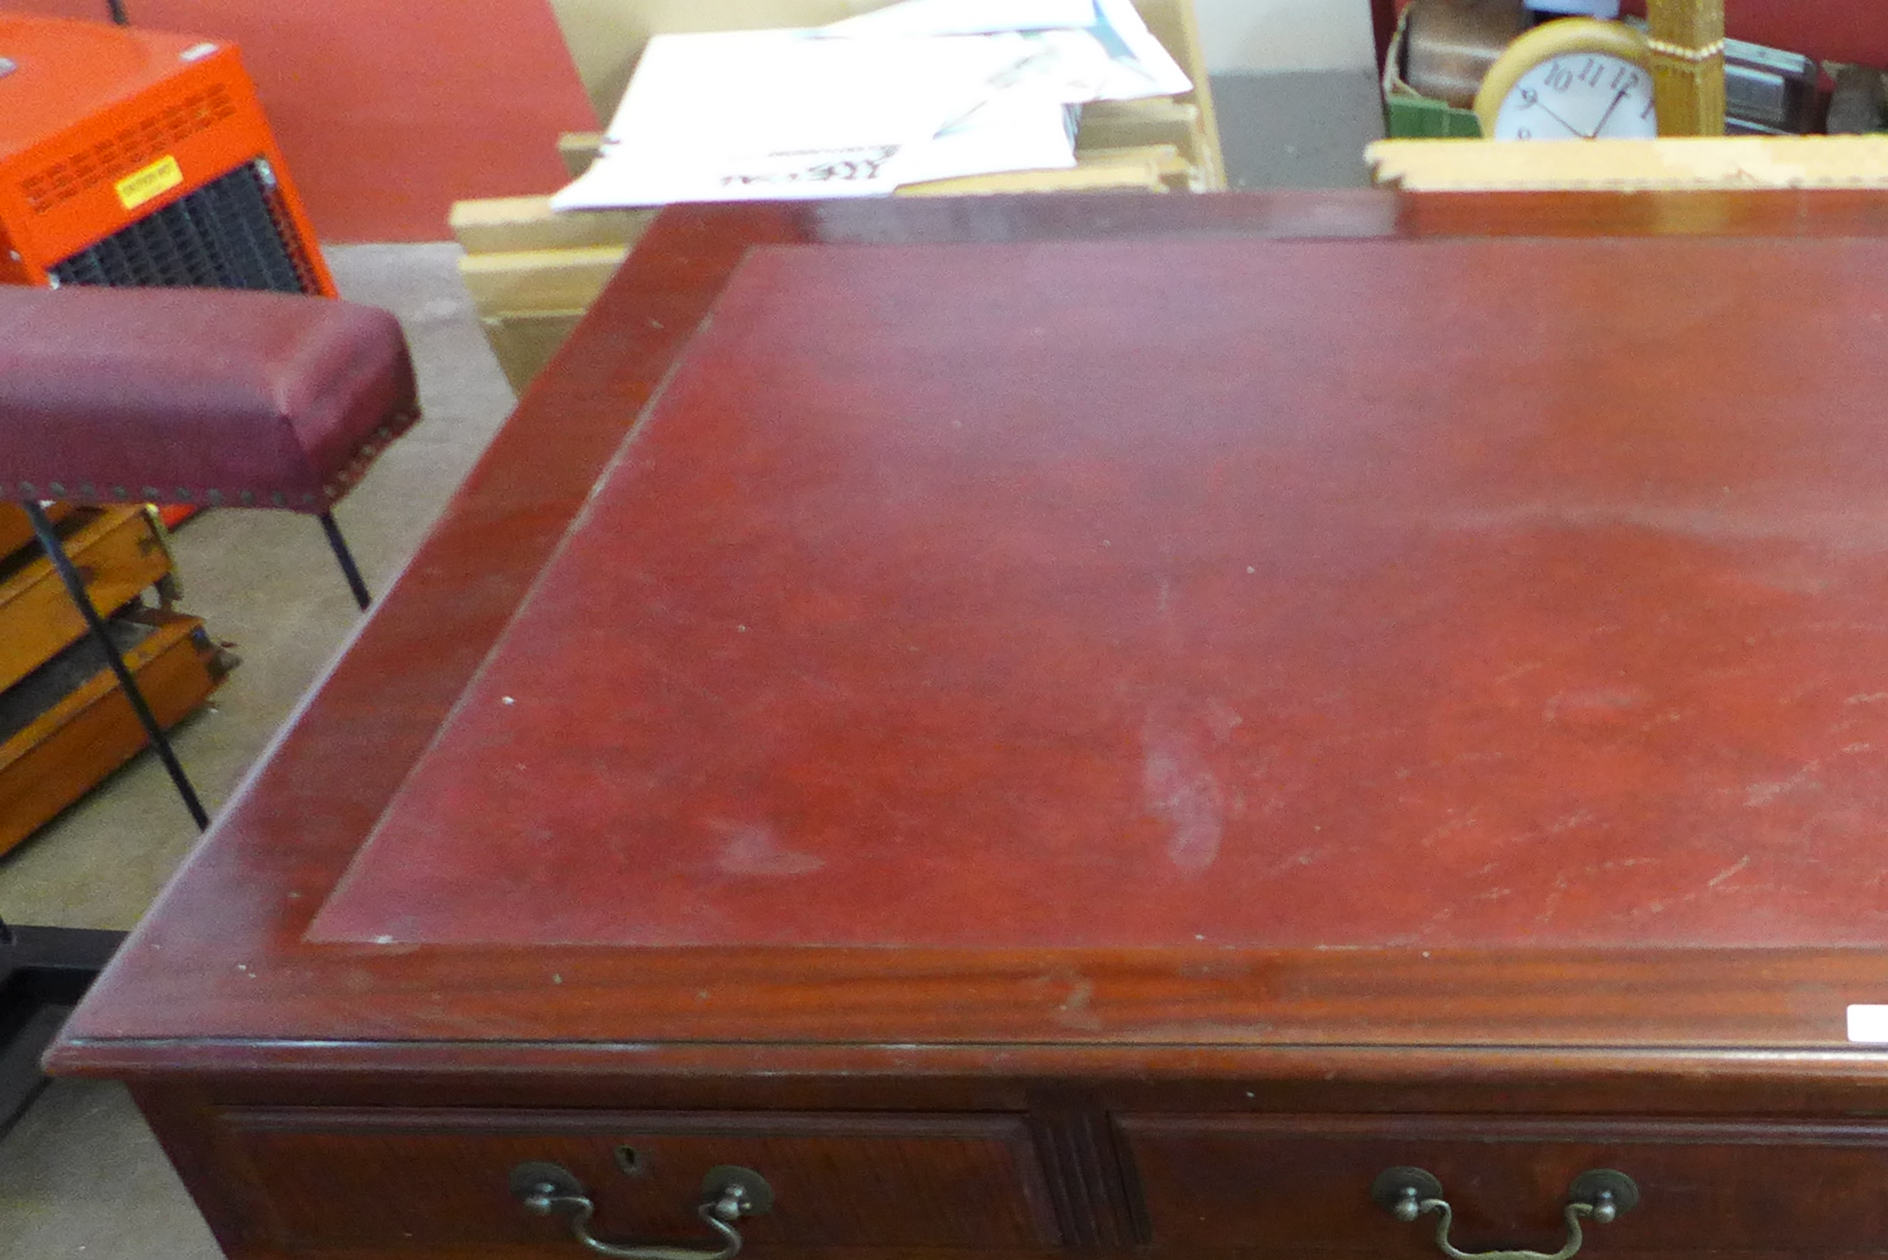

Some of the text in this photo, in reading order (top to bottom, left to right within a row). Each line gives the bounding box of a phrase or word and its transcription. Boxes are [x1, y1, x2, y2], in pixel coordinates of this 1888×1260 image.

[1544, 61, 1573, 92] 10
[1578, 57, 1605, 88] 11
[1610, 66, 1639, 97] 12
[1517, 87, 1538, 110] 9
